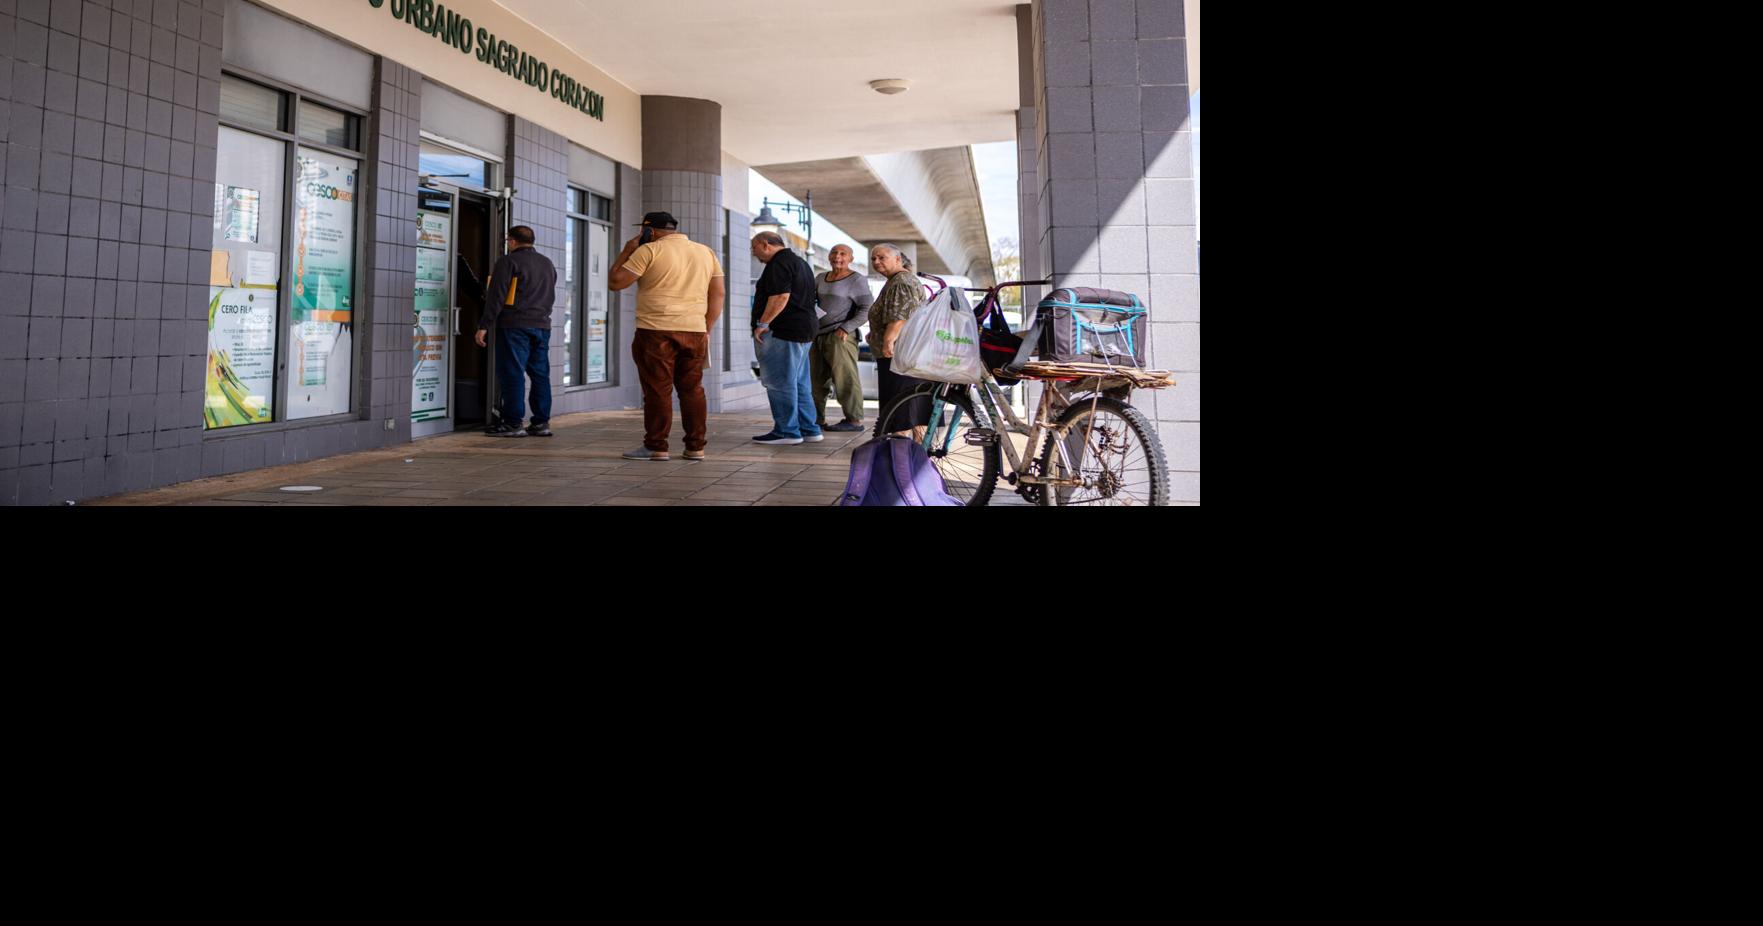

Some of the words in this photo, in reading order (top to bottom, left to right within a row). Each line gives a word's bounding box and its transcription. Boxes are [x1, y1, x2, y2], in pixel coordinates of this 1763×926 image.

[476, 27, 548, 92] SAGRADO
[550, 69, 604, 122] CORAZON
[221, 304, 239, 314] CERO
[240, 304, 253, 314] FILA
